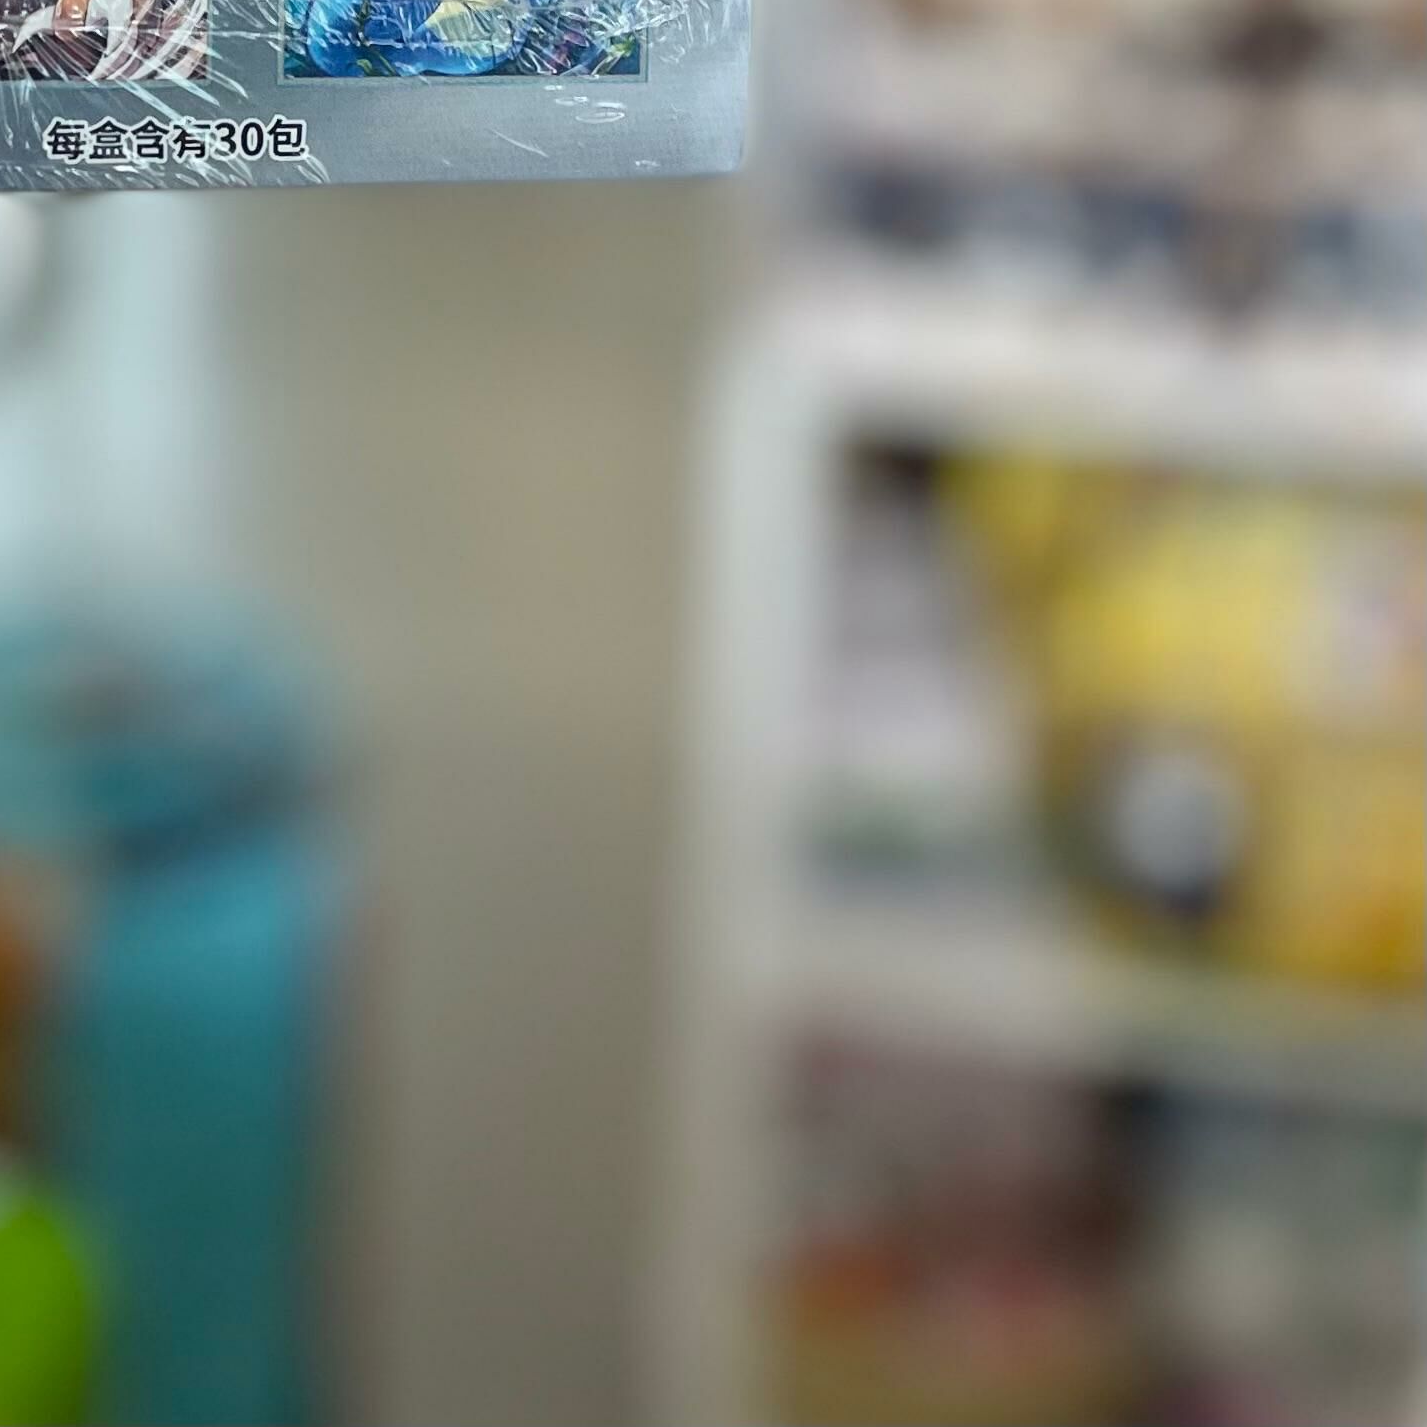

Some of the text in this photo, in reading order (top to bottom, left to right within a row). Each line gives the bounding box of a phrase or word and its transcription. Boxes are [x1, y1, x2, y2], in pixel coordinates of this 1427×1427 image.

[45, 117, 308, 162] 每盒含有30包
